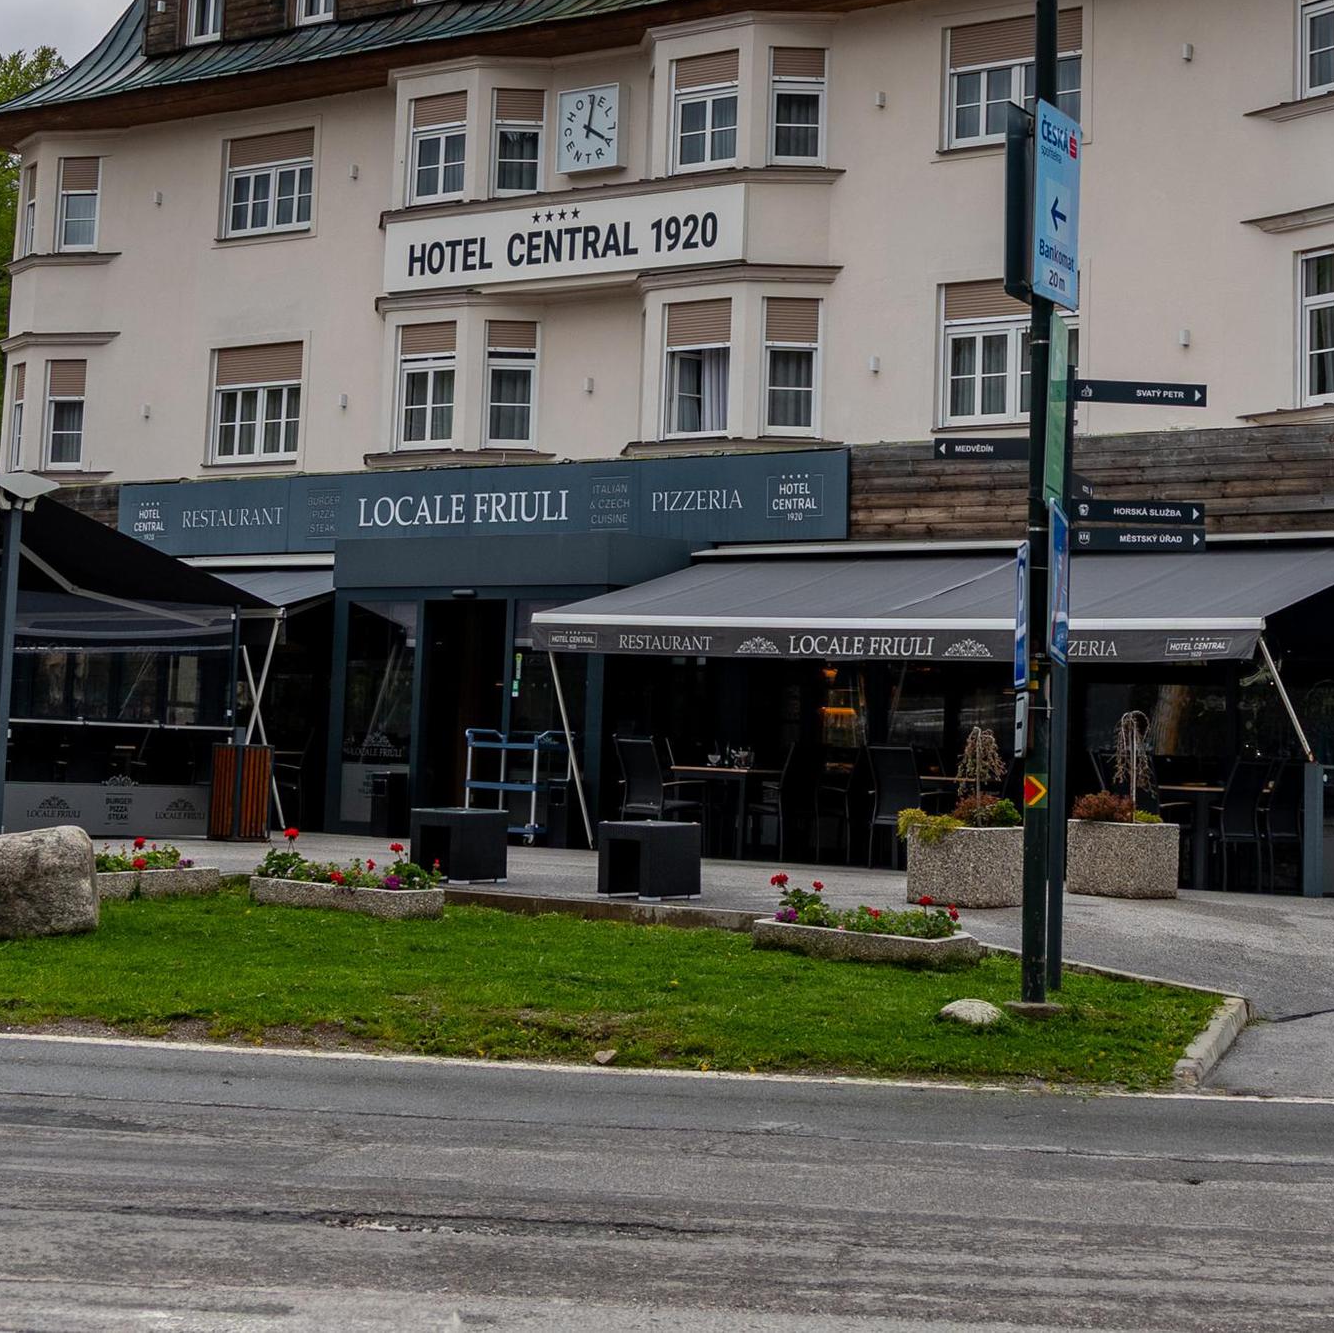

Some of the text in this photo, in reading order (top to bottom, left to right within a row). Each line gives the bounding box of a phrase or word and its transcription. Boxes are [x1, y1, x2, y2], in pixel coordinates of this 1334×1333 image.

[1041, 114, 1069, 153] ČESKÁ
[408, 211, 718, 277] HOTEL CENTRAL 1920
[1039, 238, 1074, 273] Bankomat
[1048, 270, 1066, 292] 20 m
[1136, 387, 1185, 399] SVATÝ PETR
[955, 442, 994, 453] MEDVĚDÍN
[592, 482, 627, 495] ITALIAN
[779, 483, 810, 495] HOTEL
[308, 495, 340, 505] BURGER
[598, 498, 630, 509] CZECH
[652, 489, 743, 512] PIZZERIA
[772, 498, 817, 511] CENTRAL
[139, 509, 160, 520] HOTEL
[312, 510, 335, 519] PIZZA
[358, 490, 569, 527] LOCALE FRIULI
[1113, 506, 1182, 518] HORSKÁ SLUŽBA
[182, 507, 284, 528] RESTAURANT
[591, 513, 628, 525] CUISINE
[787, 512, 803, 521] 1920
[134, 521, 165, 532] CENTRAL
[309, 524, 336, 533] STEAK
[1119, 531, 1183, 543] MĚSTSKÝ ÚŘAD
[551, 635, 594, 644] HOTEL CENTRAL
[619, 634, 713, 651] RESTAURANT
[788, 635, 935, 656] LOCALE FRIULI
[1067, 640, 1118, 657] ZERIA
[1170, 641, 1226, 651] HOTEL CENTRAL
[106, 797, 133, 806] BURGER
[27, 810, 56, 818] LOCALE
[155, 810, 182, 819] LOCALE
